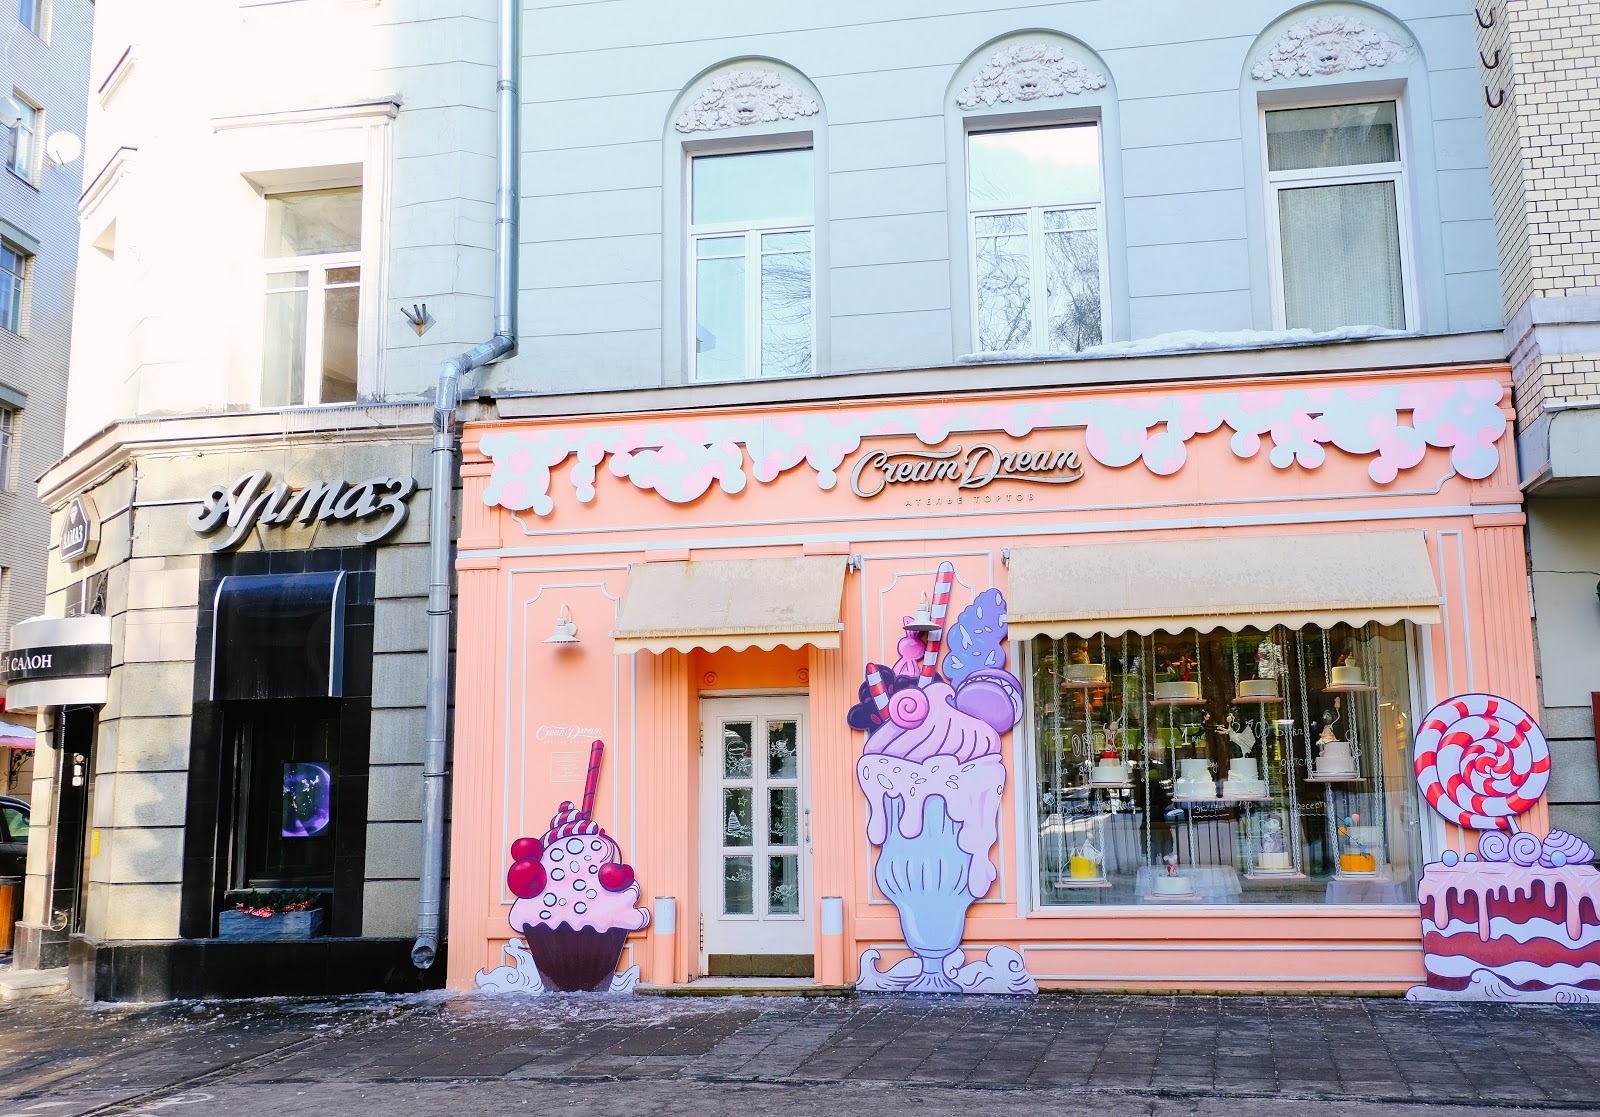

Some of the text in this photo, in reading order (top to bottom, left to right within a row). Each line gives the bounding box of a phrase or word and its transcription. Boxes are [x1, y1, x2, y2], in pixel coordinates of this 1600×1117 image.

[850, 442, 1085, 498] Cream Dream
[904, 492, 1035, 507] АТЕЛЬЕ ТОРТОВ
[187, 468, 418, 551] Алмаз
[11, 654, 53, 671] САЛОН
[535, 725, 604, 740] Cream Dream
